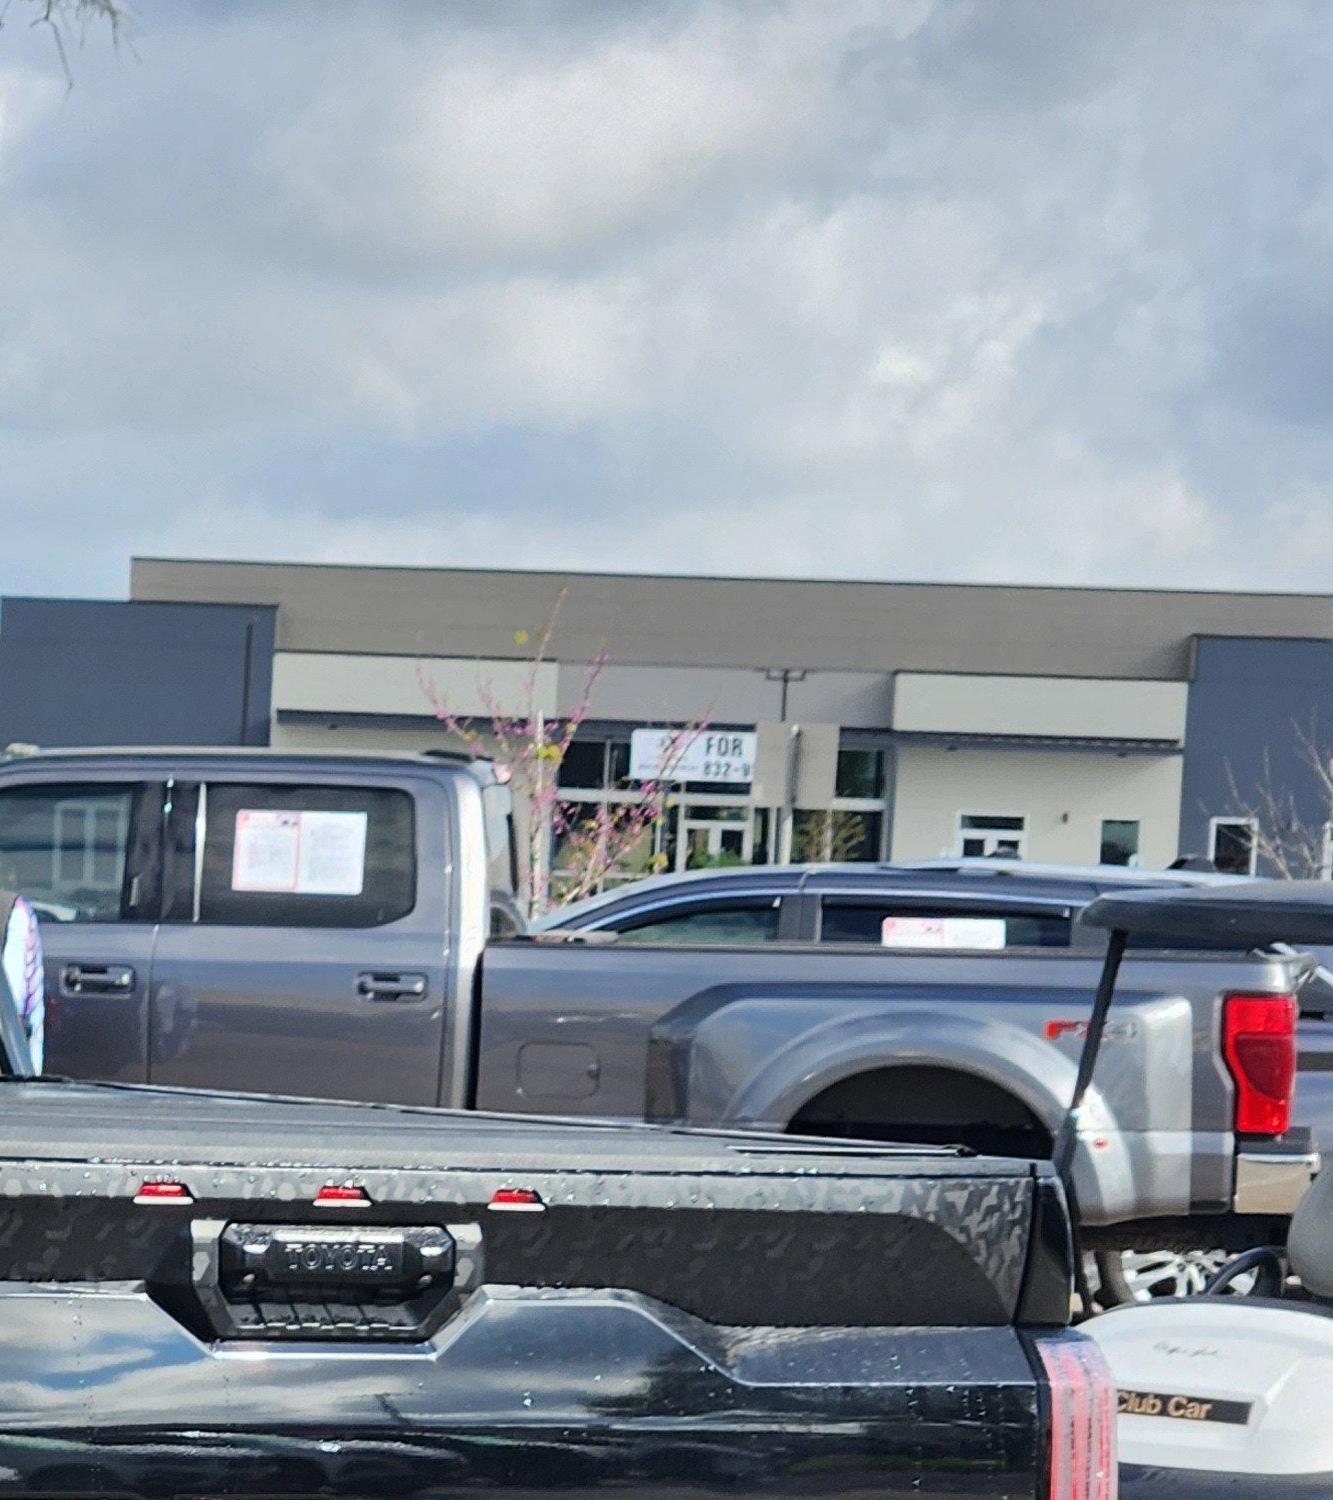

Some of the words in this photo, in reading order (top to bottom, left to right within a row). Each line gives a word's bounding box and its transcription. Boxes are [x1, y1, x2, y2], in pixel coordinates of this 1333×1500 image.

[705, 736, 744, 759] FOR
[283, 1242, 395, 1271] TOYOTA
[1117, 1391, 1162, 1415] Club
[1167, 1395, 1213, 1420] Car
